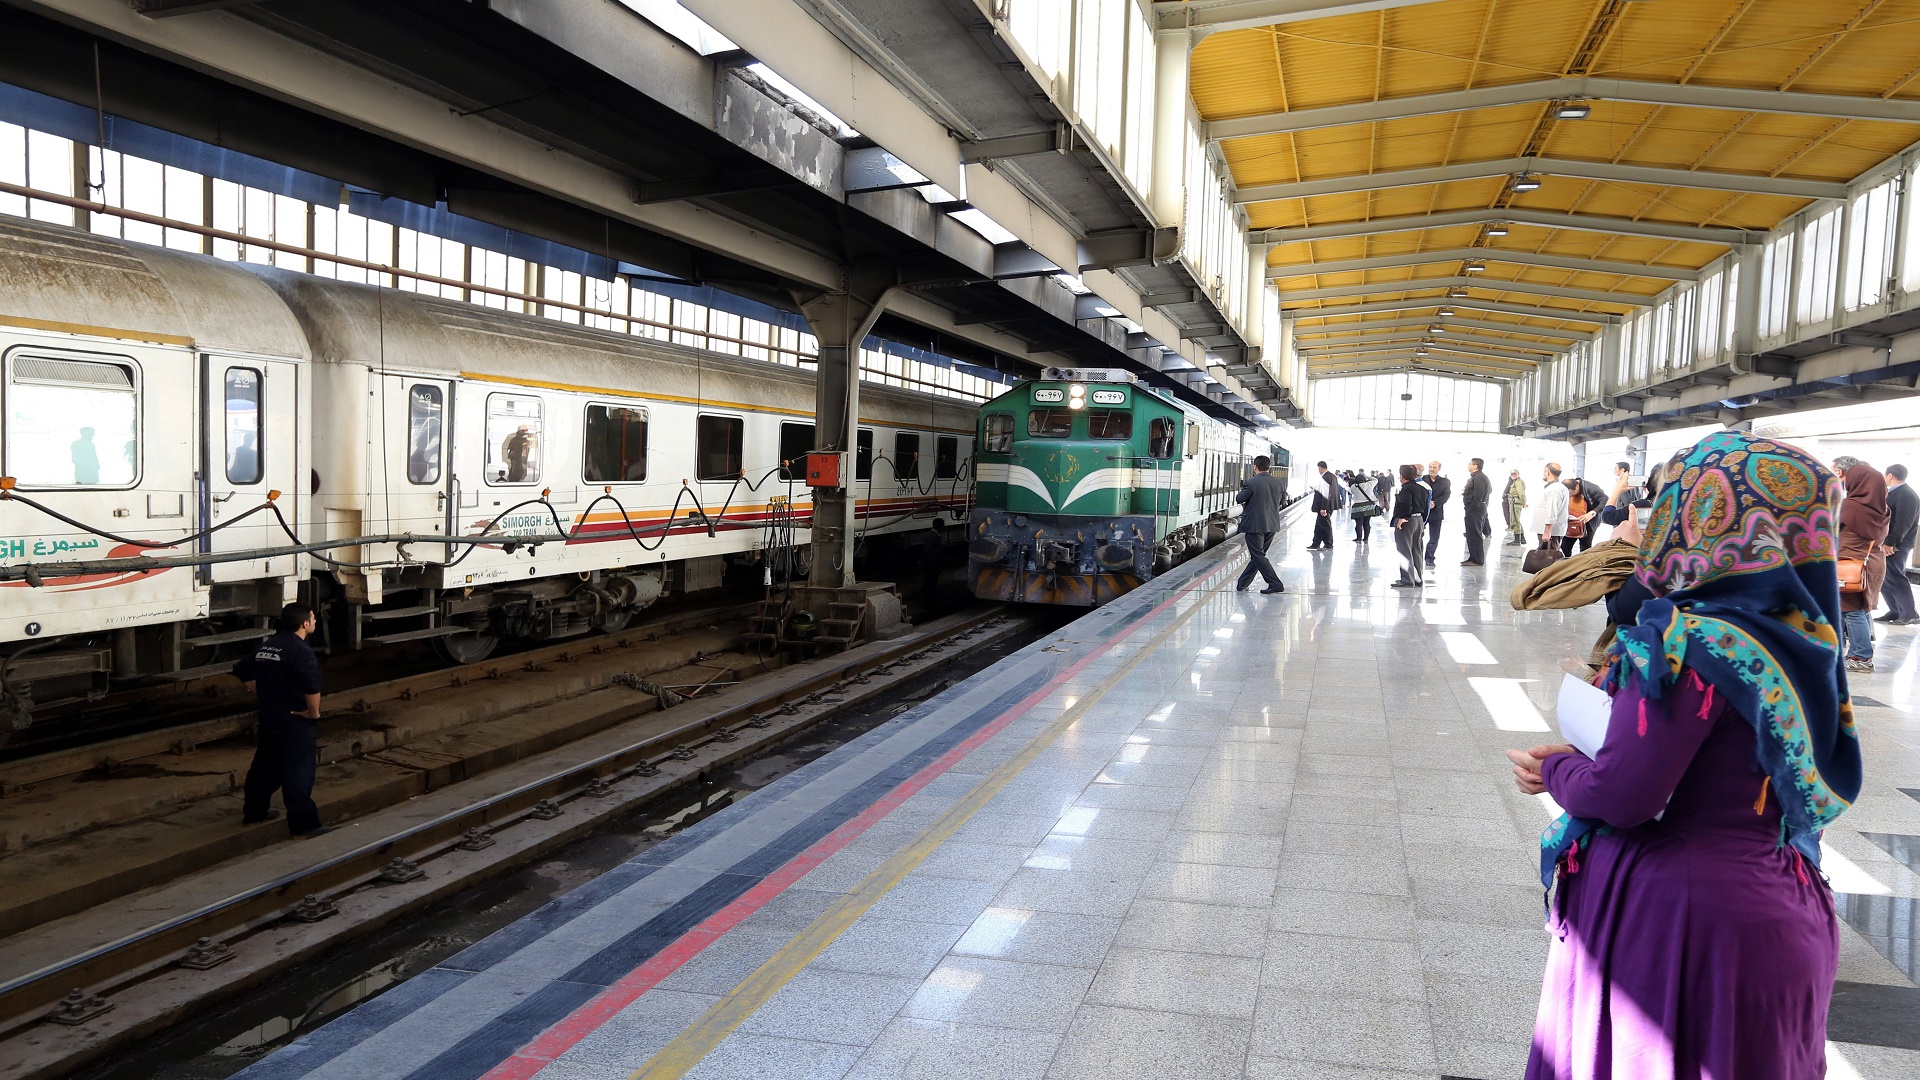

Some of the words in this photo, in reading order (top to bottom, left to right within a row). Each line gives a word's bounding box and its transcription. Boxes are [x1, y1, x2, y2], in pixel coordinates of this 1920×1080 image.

[502, 516, 542, 529] SIMORGH
[523, 528, 537, 536] TRAIN
[33, 538, 99, 556] سیمرغ
